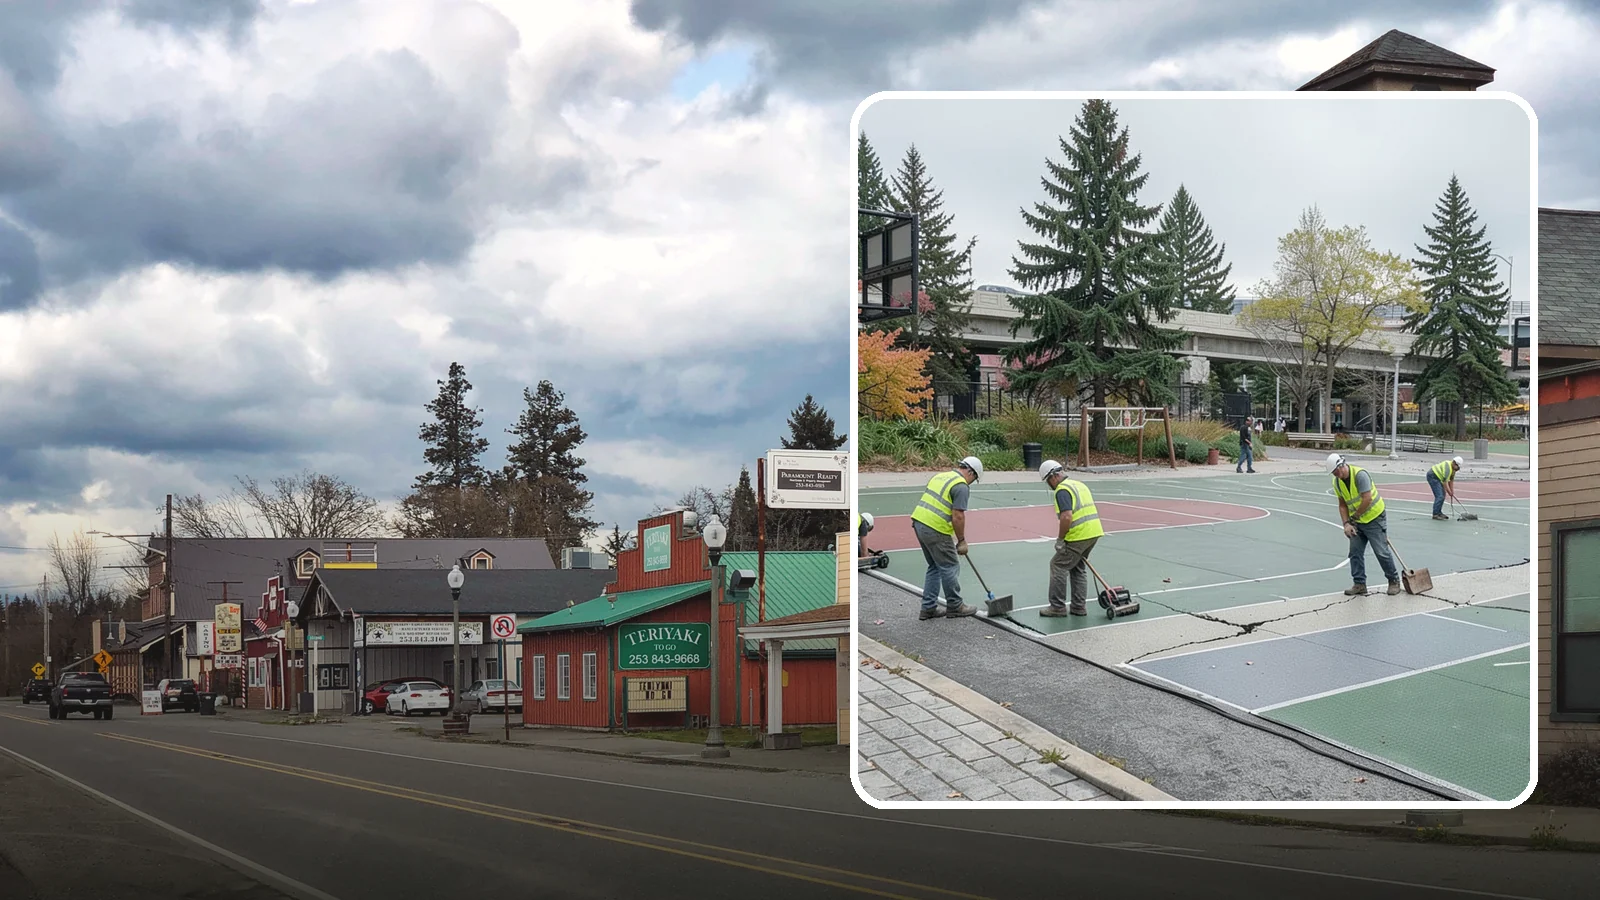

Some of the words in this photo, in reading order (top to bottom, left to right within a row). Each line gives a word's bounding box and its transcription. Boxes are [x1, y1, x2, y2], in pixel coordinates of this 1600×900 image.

[624, 627, 702, 646] TERIYAKI
[628, 654, 649, 665] 253
[651, 653, 700, 664] 843-9668
[639, 681, 673, 691] TERIYAKI
